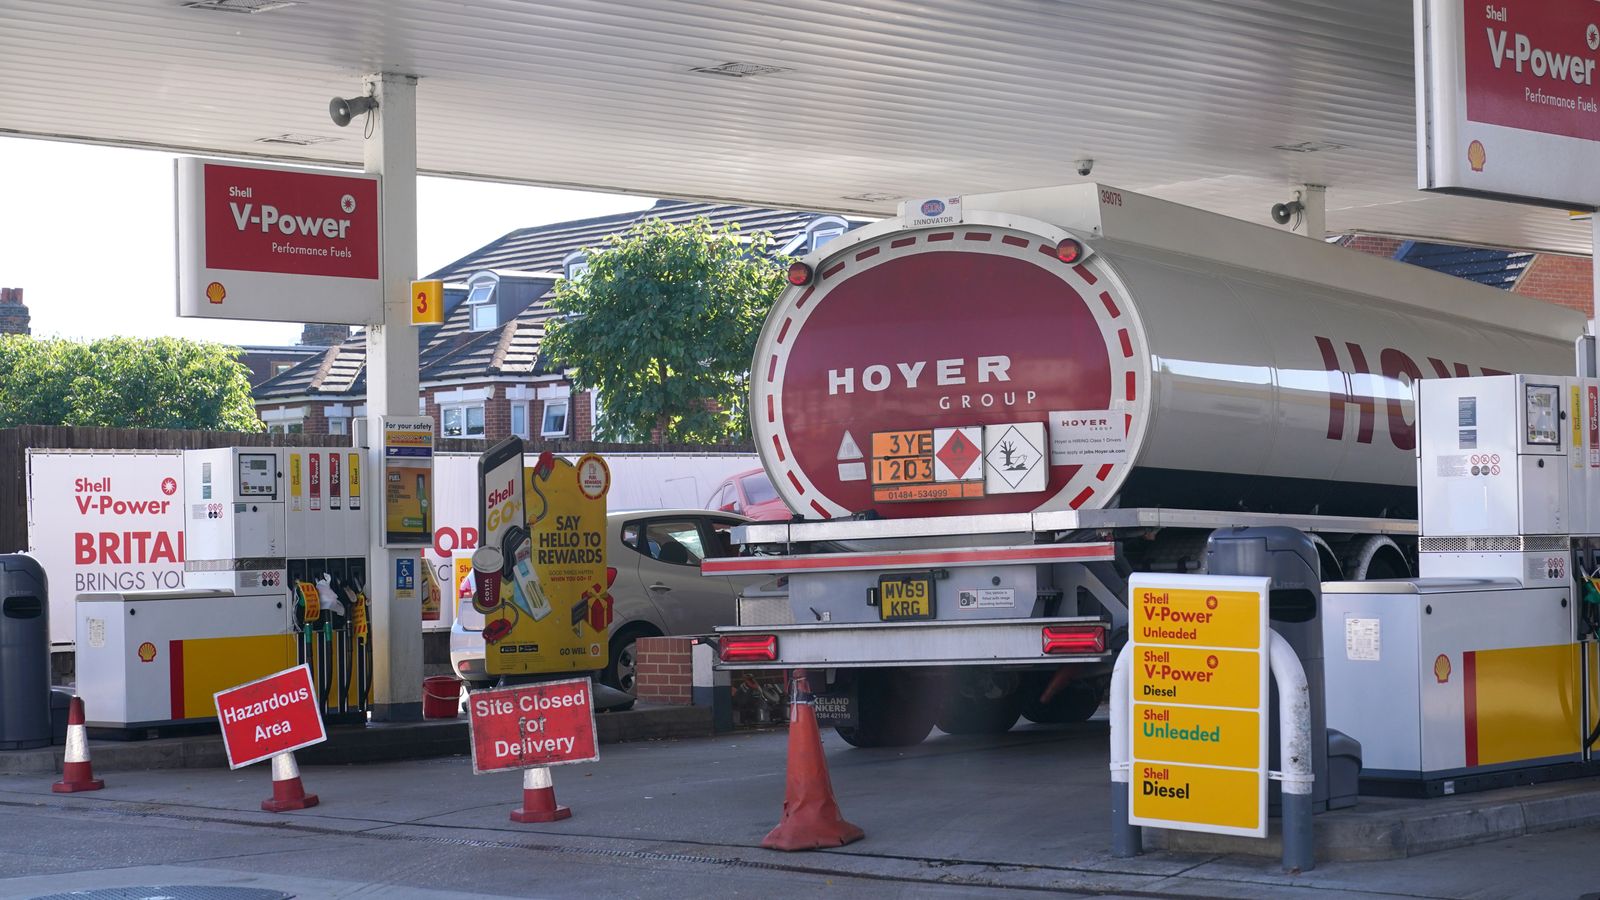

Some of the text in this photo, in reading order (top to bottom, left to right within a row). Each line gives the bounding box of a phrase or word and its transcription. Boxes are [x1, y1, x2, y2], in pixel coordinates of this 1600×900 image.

[1486, 5, 1507, 22] Shell
[1487, 28, 1595, 85] V-Power
[1525, 87, 1597, 112] Performance Fuels
[229, 186, 252, 198] Shell
[1102, 190, 1122, 207] 39079
[230, 202, 350, 238] V-Power
[914, 217, 953, 225] INNOVATOR
[272, 242, 352, 258] Performance Fuels
[417, 292, 427, 314] 3
[828, 355, 1012, 395] HOYER
[939, 391, 1036, 410] GROUP
[413, 423, 432, 431] safety
[1062, 419, 1107, 427] HOYER
[890, 434, 932, 454] 3YE
[878, 459, 932, 480] 1203
[75, 477, 111, 493] Shell
[488, 479, 514, 509] Shell
[888, 489, 948, 499] 01484-534999
[75, 495, 170, 515] V-Power
[556, 516, 581, 531] SAY
[539, 532, 601, 548] HELLO TO
[538, 549, 603, 565] REWARDS
[75, 571, 146, 592] BRINGS
[885, 581, 925, 598] MV69
[1143, 593, 1169, 604] Shell
[891, 600, 920, 617] KRG
[1144, 606, 1213, 623] V-Power
[1143, 627, 1197, 640] Unleaded
[571, 647, 586, 655] WELL
[1144, 651, 1169, 663] Shell
[1144, 664, 1213, 682] V-Power
[1143, 685, 1176, 697] Diesel
[224, 688, 309, 724] Hazardous
[476, 690, 585, 717] Site Closed
[815, 697, 849, 705] KELAND
[1144, 709, 1169, 721] Shell
[255, 720, 291, 742] Area
[518, 717, 547, 733] for
[1143, 722, 1220, 742] Unleaded
[495, 736, 575, 758] Delivery
[1144, 768, 1169, 780] Shell
[1143, 781, 1190, 800] Diesel
